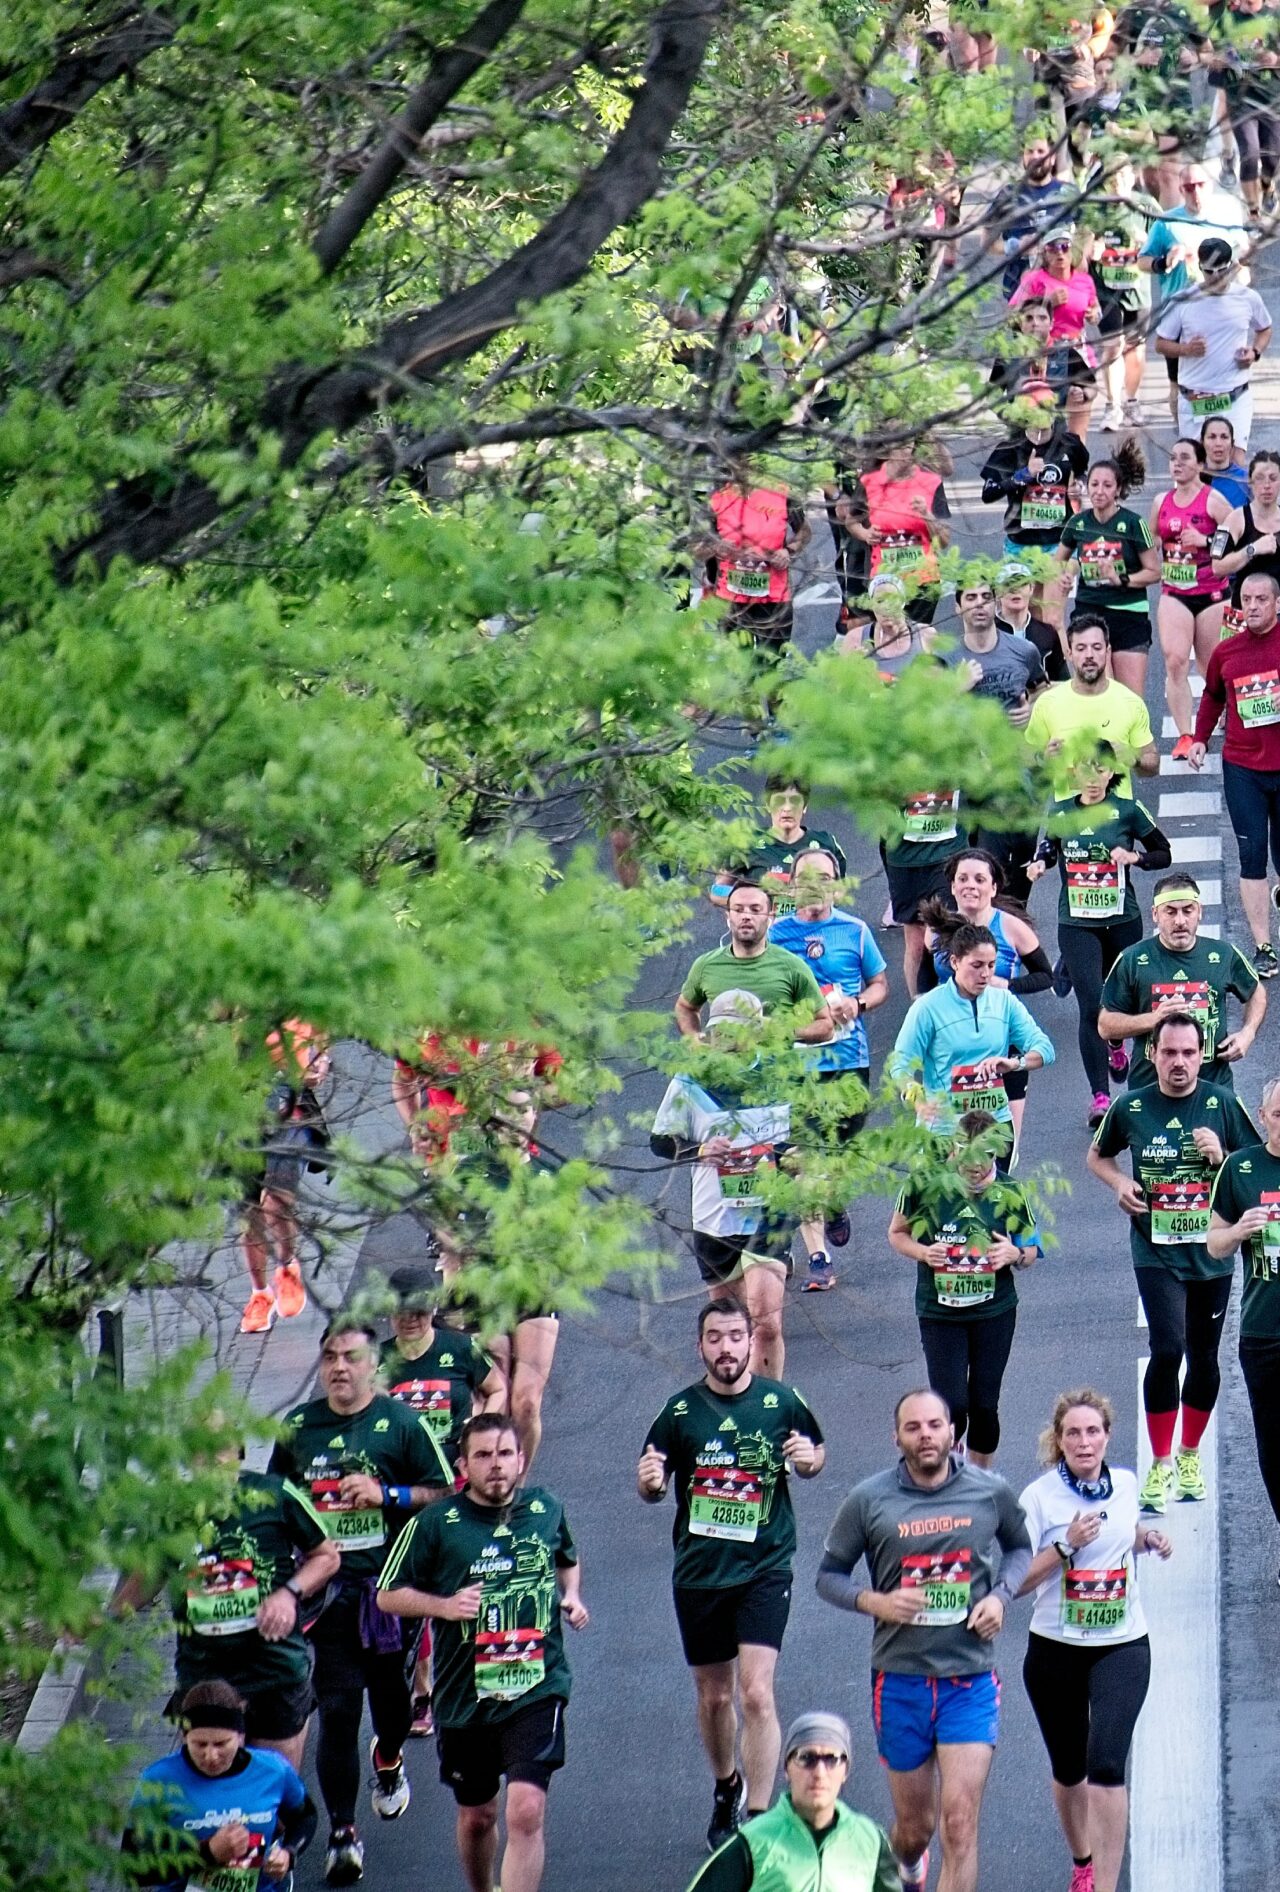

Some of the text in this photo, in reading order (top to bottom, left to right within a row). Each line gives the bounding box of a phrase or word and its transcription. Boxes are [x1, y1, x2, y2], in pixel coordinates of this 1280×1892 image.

[1142, 1148, 1177, 1158] MADRID
[1171, 1219, 1200, 1231] 42804
[934, 1234, 967, 1244] MADRID
[696, 1453, 735, 1466] MADRID
[711, 1506, 745, 1525] 42859
[336, 1516, 370, 1536] 42384
[469, 1560, 513, 1574] MADRID
[213, 1594, 247, 1618] 40821
[925, 1591, 956, 1608] 2630
[488, 1608, 497, 1632] 2017
[498, 1669, 532, 1686] 41500
